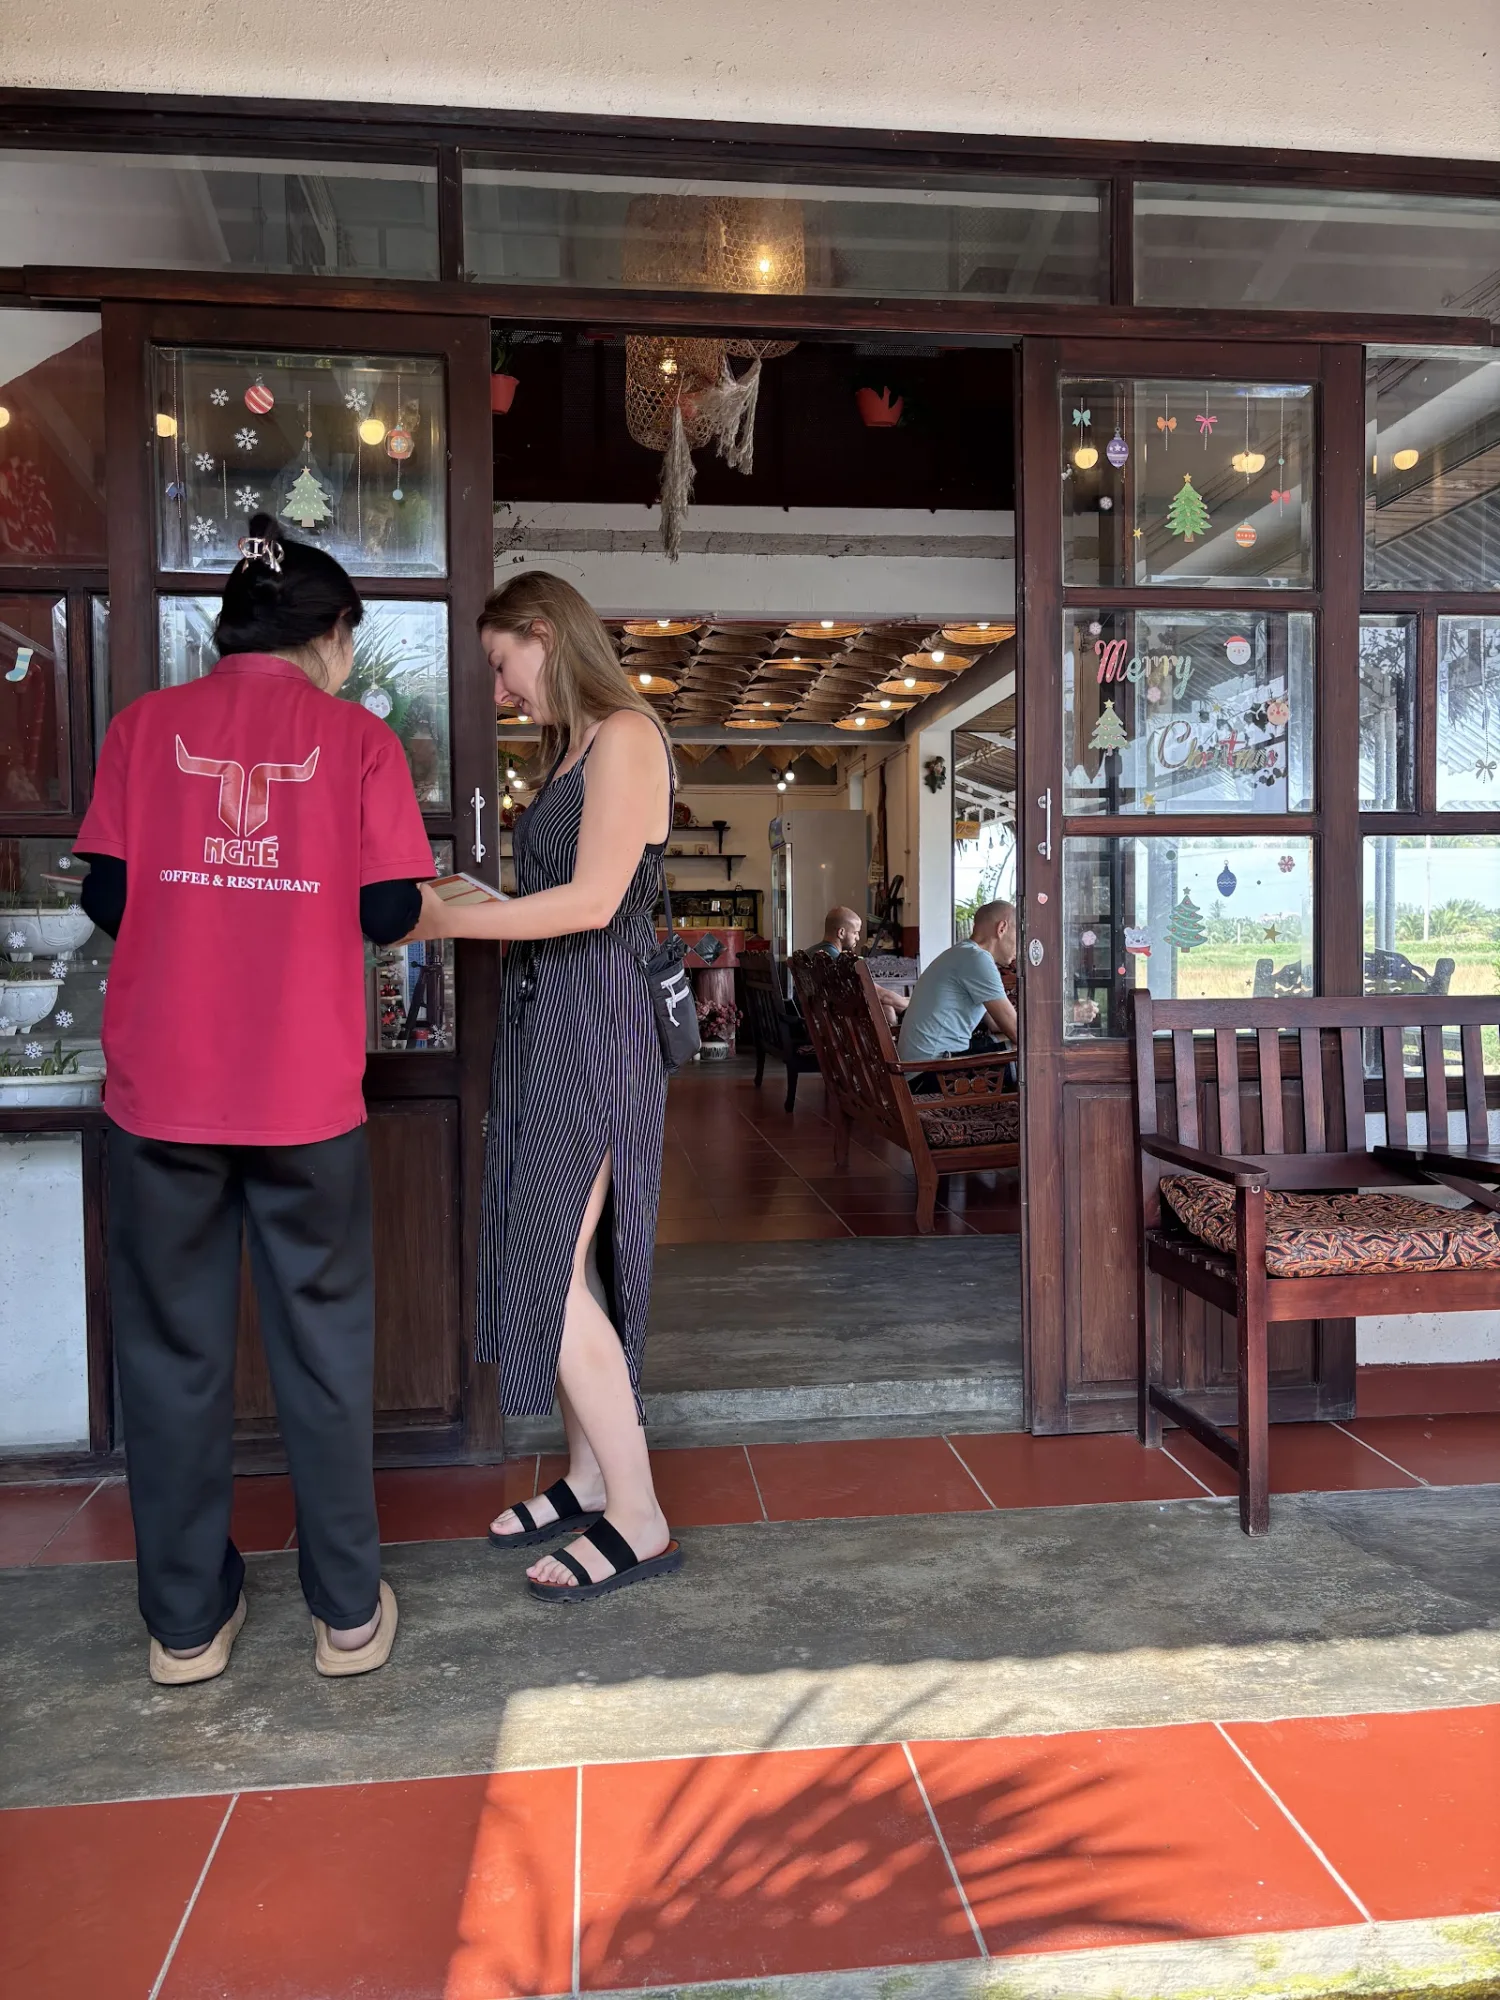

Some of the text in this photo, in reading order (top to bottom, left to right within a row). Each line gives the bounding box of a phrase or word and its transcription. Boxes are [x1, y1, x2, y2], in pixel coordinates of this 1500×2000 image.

[1094, 639, 1195, 700] Merry
[204, 835, 279, 868] NGHÉ
[159, 869, 321, 894] COFFEE & RESTAURANT
